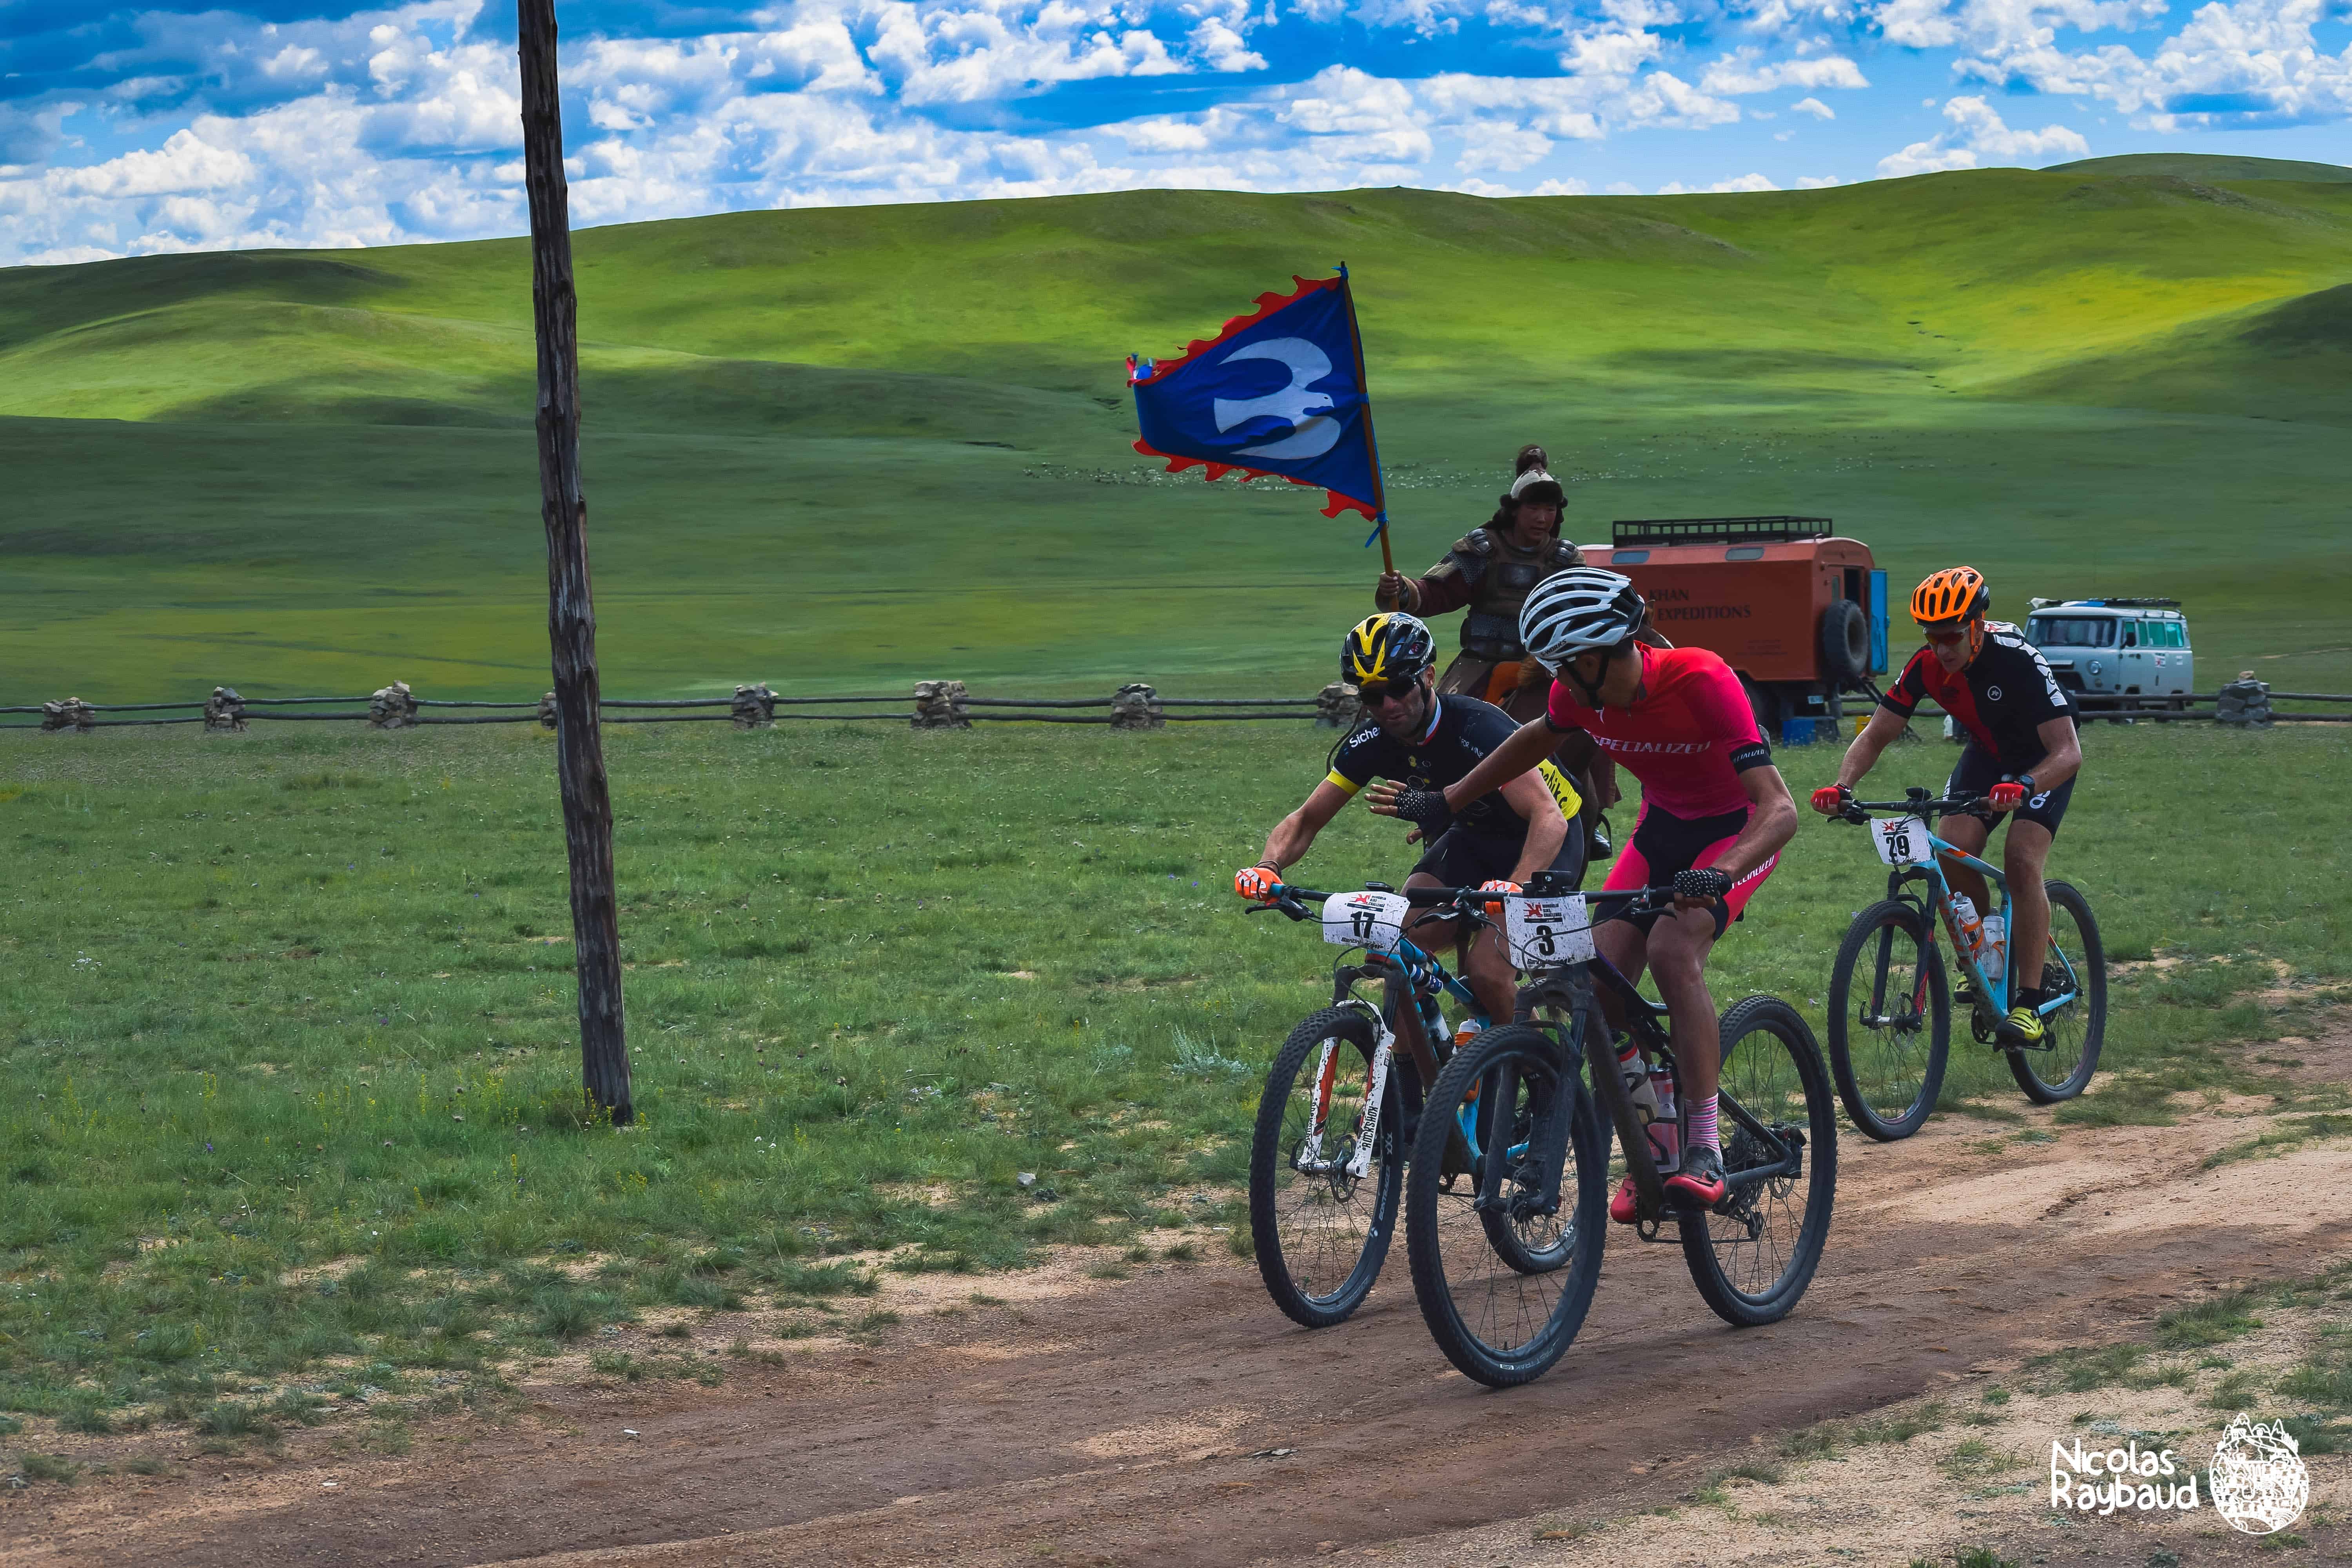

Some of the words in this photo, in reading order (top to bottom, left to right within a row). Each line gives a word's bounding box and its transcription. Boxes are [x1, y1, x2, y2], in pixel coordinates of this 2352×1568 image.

[1649, 589, 1689, 601] KHAN
[1658, 605, 1751, 621] EXPEDITIONS
[1349, 727, 1380, 748] Siche
[1886, 835, 1910, 857] 29
[1350, 911, 1376, 939] 17
[1536, 925, 1555, 956] 3
